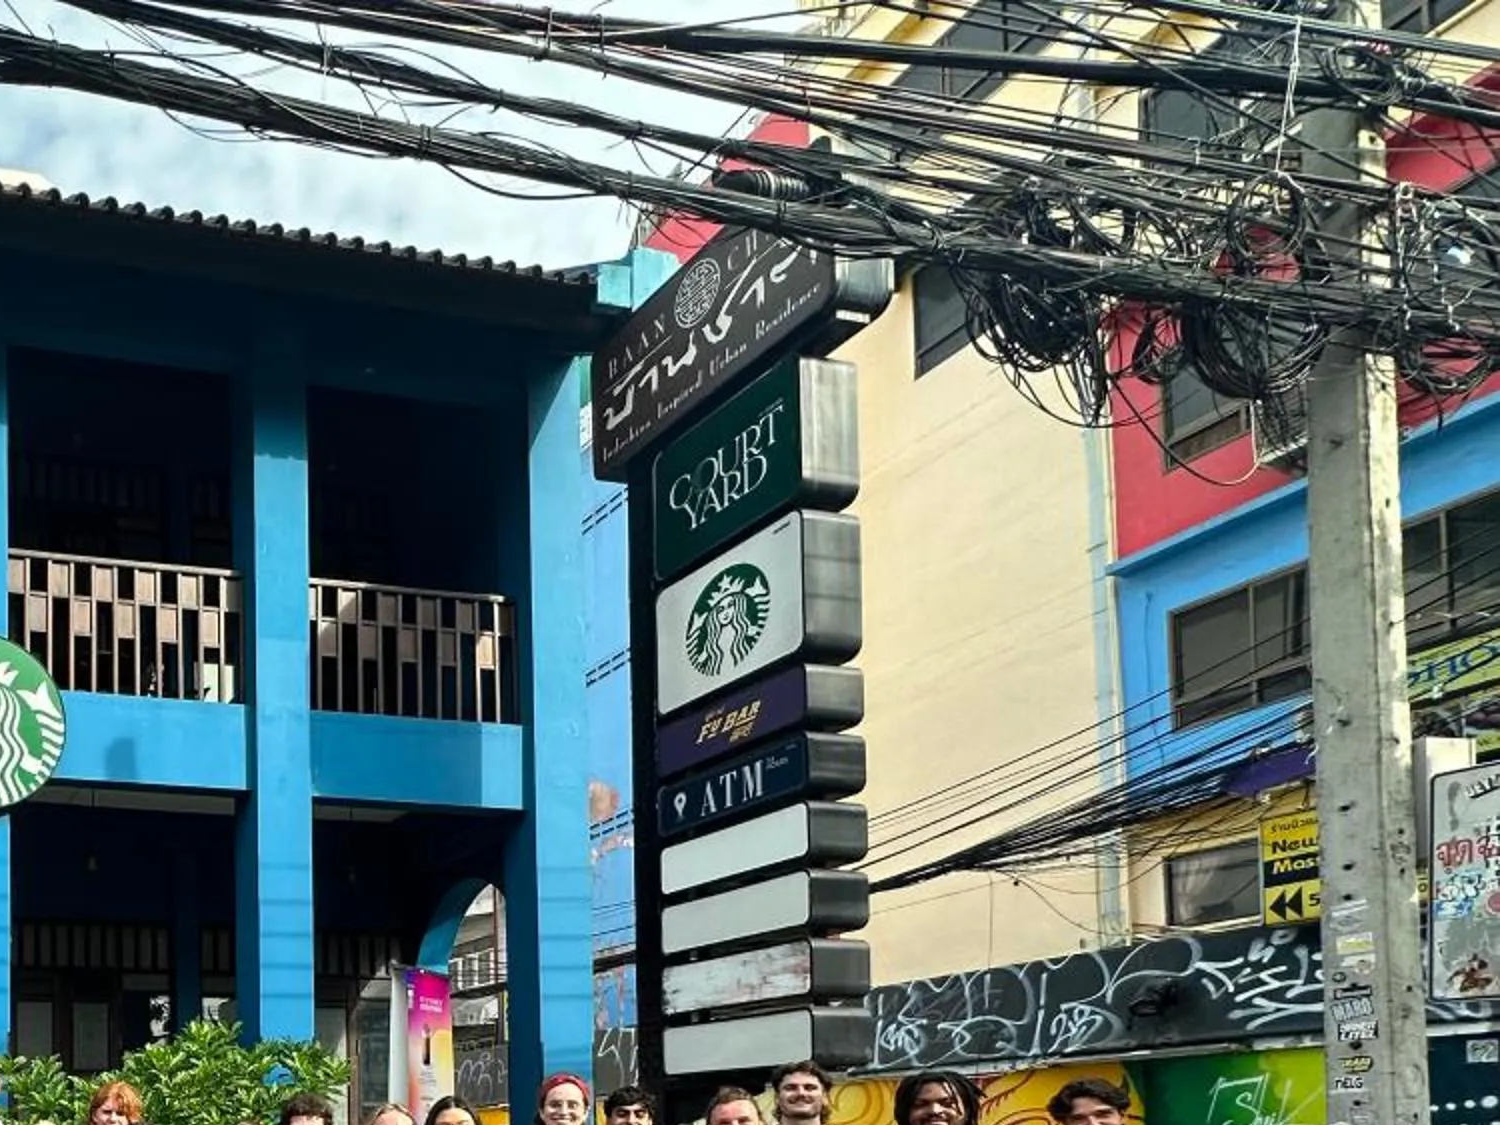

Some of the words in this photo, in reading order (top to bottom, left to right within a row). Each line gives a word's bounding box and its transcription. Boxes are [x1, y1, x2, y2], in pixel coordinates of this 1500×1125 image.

[669, 404, 784, 510] COURT
[683, 455, 767, 529] YARD
[700, 759, 763, 817] ATM
[1272, 857, 1320, 875] Mas
